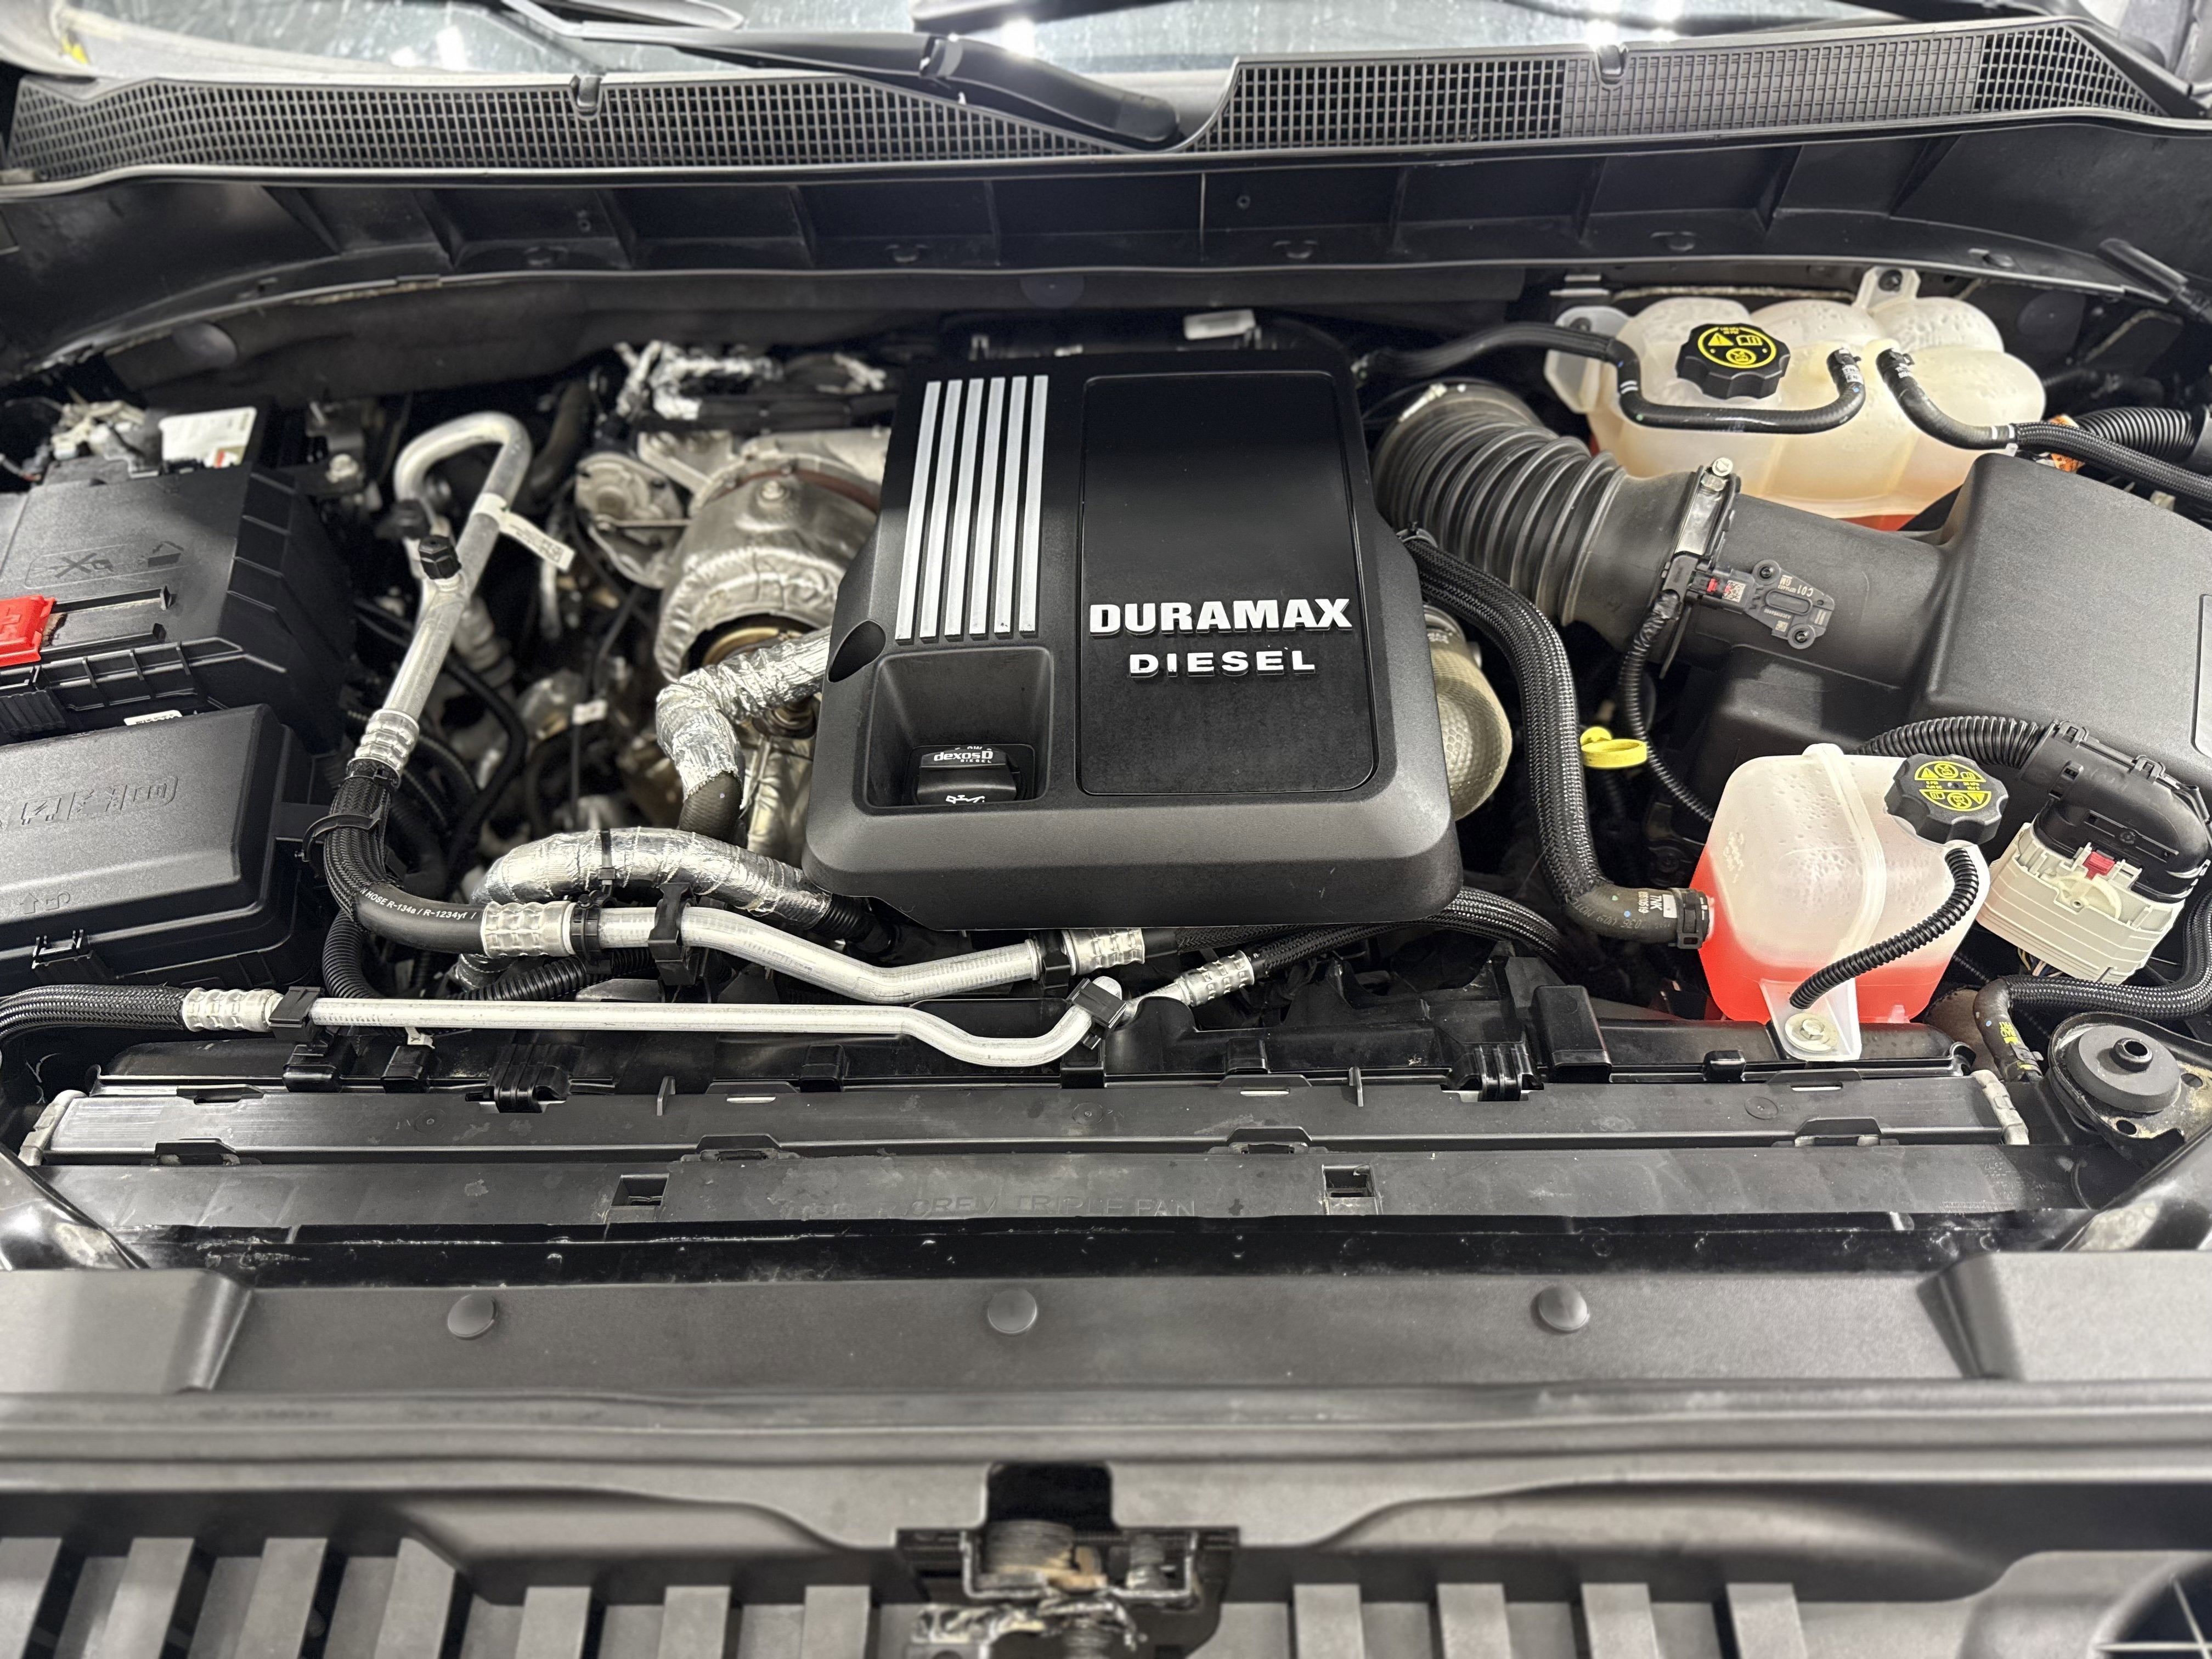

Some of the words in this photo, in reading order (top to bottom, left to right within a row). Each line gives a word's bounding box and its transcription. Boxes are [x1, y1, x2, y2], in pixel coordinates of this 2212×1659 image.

[1090, 599, 1352, 635] DURAMAX
[1130, 650, 1316, 678] DIESEL
[365, 891, 388, 905] HOSE
[386, 900, 416, 914] R-134a
[423, 909, 468, 920] R-1234yf
[1016, 1194, 1124, 1216] TRIPLE
[1136, 1198, 1195, 1217] FAN
